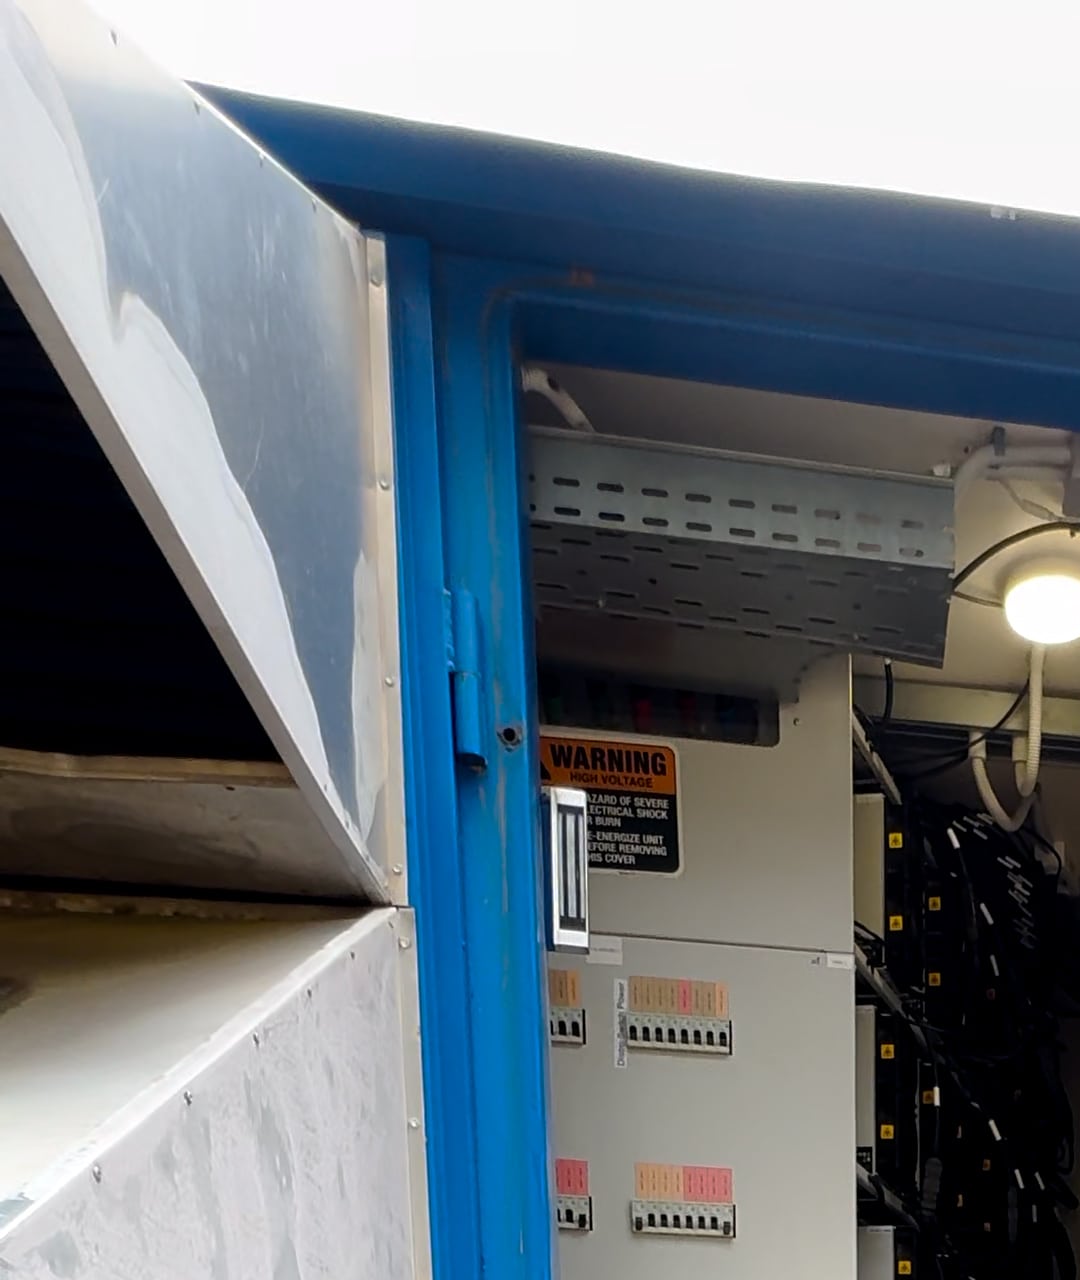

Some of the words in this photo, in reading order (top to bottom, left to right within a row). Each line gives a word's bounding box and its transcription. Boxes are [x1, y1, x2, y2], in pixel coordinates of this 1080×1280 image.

[550, 743, 667, 776] WARNING
[570, 772, 598, 783] HIGH
[601, 774, 654, 788] VOLTAGE
[587, 793, 617, 805] AZARD
[620, 795, 631, 806] OF
[634, 797, 669, 809] SEVERE
[587, 805, 634, 818] ECTRICAL
[637, 808, 668, 820] SHOCK
[595, 817, 621, 827] BURN
[587, 830, 640, 844] E-ENERGIZE
[643, 834, 664, 845] UNIT
[587, 842, 617, 852] EFORE
[619, 843, 668, 856] REMOVING
[587, 853, 602, 862] HIS
[605, 854, 636, 864] COVER
[617, 982, 625, 1009] Power
